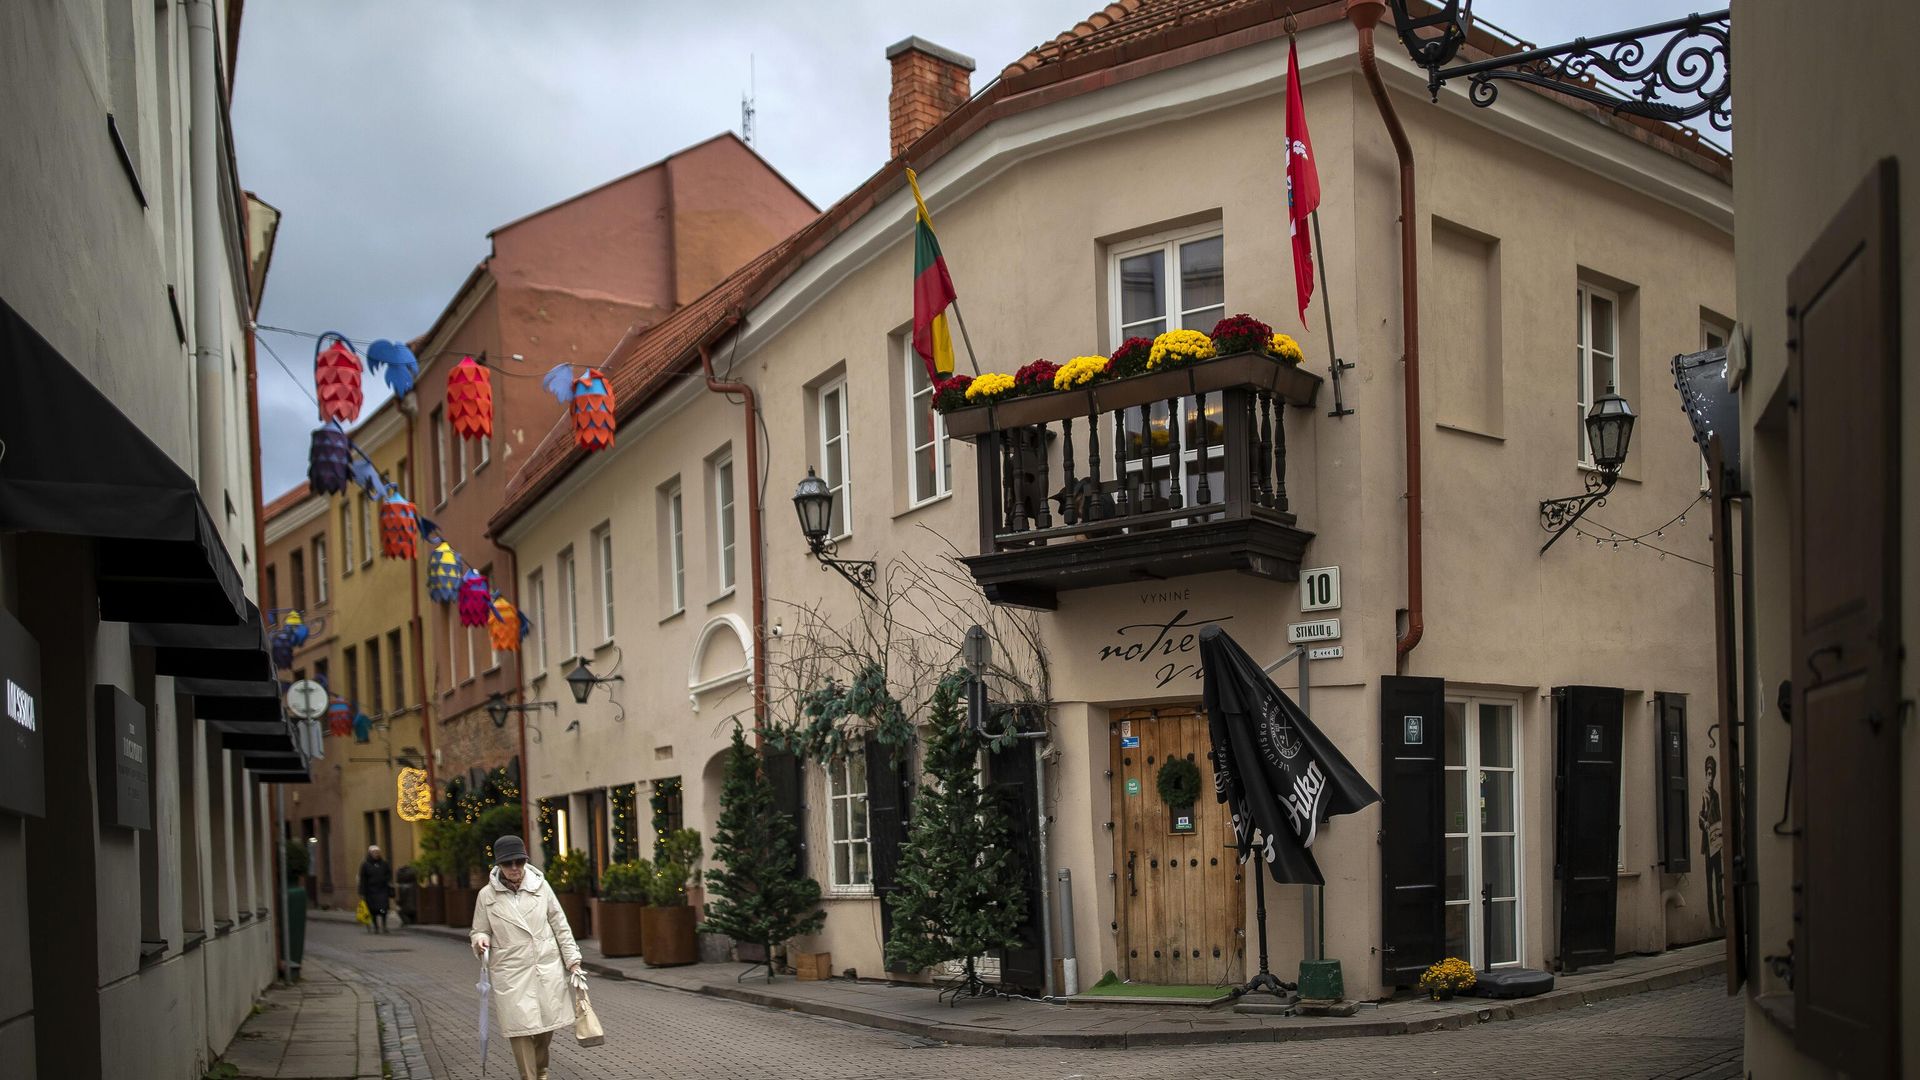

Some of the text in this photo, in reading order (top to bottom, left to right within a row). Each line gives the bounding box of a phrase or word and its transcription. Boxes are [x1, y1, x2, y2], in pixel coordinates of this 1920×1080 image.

[1140, 588, 1191, 604] VYNINĖ
[1306, 573, 1331, 606] 10
[1098, 609, 1234, 662] notre
[1326, 625, 1334, 637] g.
[1313, 648, 1340, 658] 2 10
